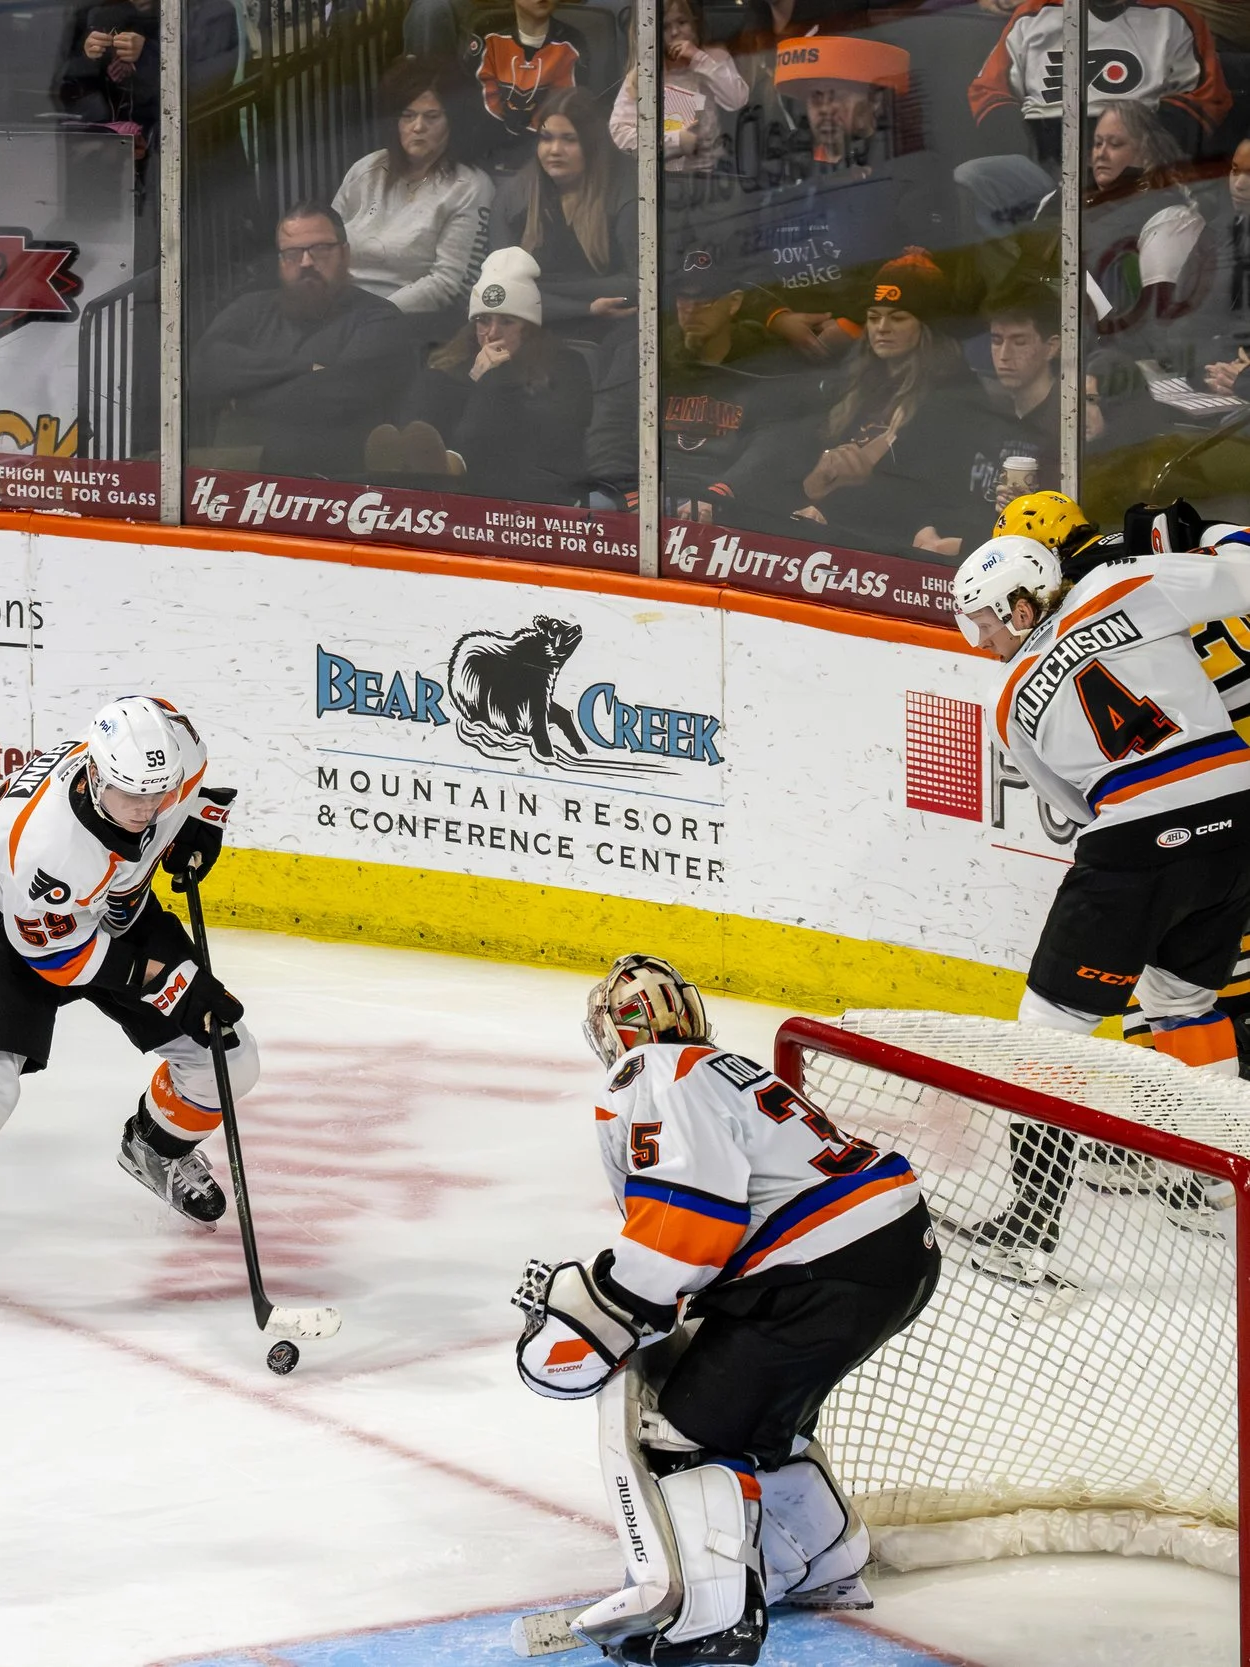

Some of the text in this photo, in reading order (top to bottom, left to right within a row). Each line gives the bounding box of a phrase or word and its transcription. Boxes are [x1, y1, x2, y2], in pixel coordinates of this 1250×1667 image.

[7, 483, 63, 500] CHOICE
[71, 487, 100, 503] FOR
[108, 491, 156, 506] GLASS
[53, 469, 120, 487] VALLEY'S
[238, 481, 348, 525] HUTT'S
[347, 492, 449, 535] GLASS
[485, 511, 604, 537] LEHIGH VALLEY'S
[452, 525, 638, 557] CLEAR CHOICE FOR GLASS
[705, 534, 802, 582] HUTT'S
[800, 551, 890, 598] GLASS
[893, 589, 930, 608] CLEAR
[1015, 612, 1138, 738] MURCHISON
[316, 643, 726, 766] BEAR CREEK
[1073, 659, 1183, 763] 4
[145, 749, 166, 768] 59
[141, 775, 170, 785] CCM
[316, 766, 726, 845] MOUNTAIN RESORT
[317, 804, 726, 884] & CONFERENCE CENTER
[1195, 819, 1233, 835] CCM
[14, 911, 78, 948] 59
[630, 1121, 663, 1170] 5
